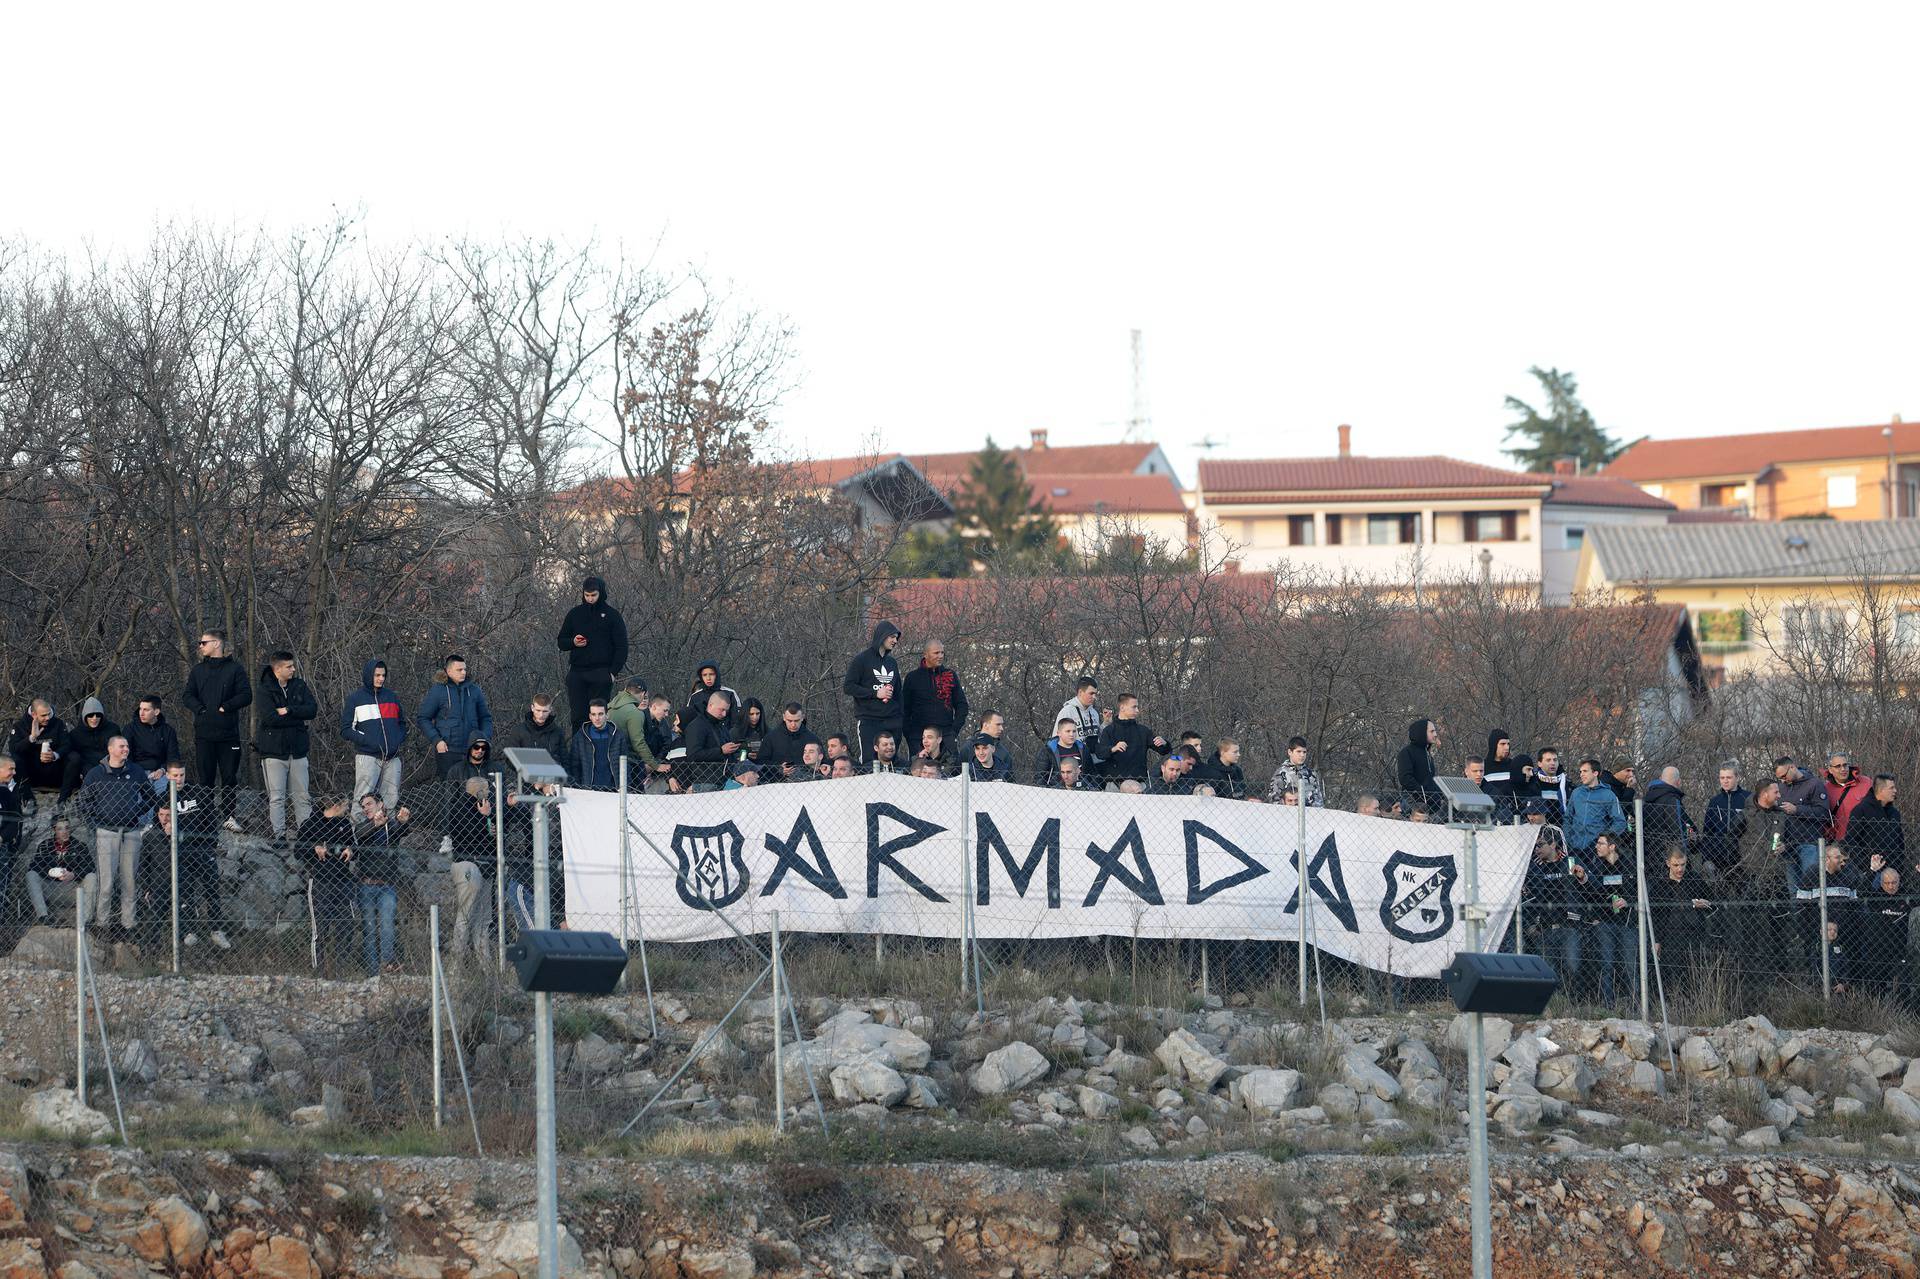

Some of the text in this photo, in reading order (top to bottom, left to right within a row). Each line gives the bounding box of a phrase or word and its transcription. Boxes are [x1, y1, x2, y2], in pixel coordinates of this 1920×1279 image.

[760, 802, 1359, 934] ARMADA
[1402, 870, 1417, 884] NK
[1391, 872, 1448, 920] RIJEKA
